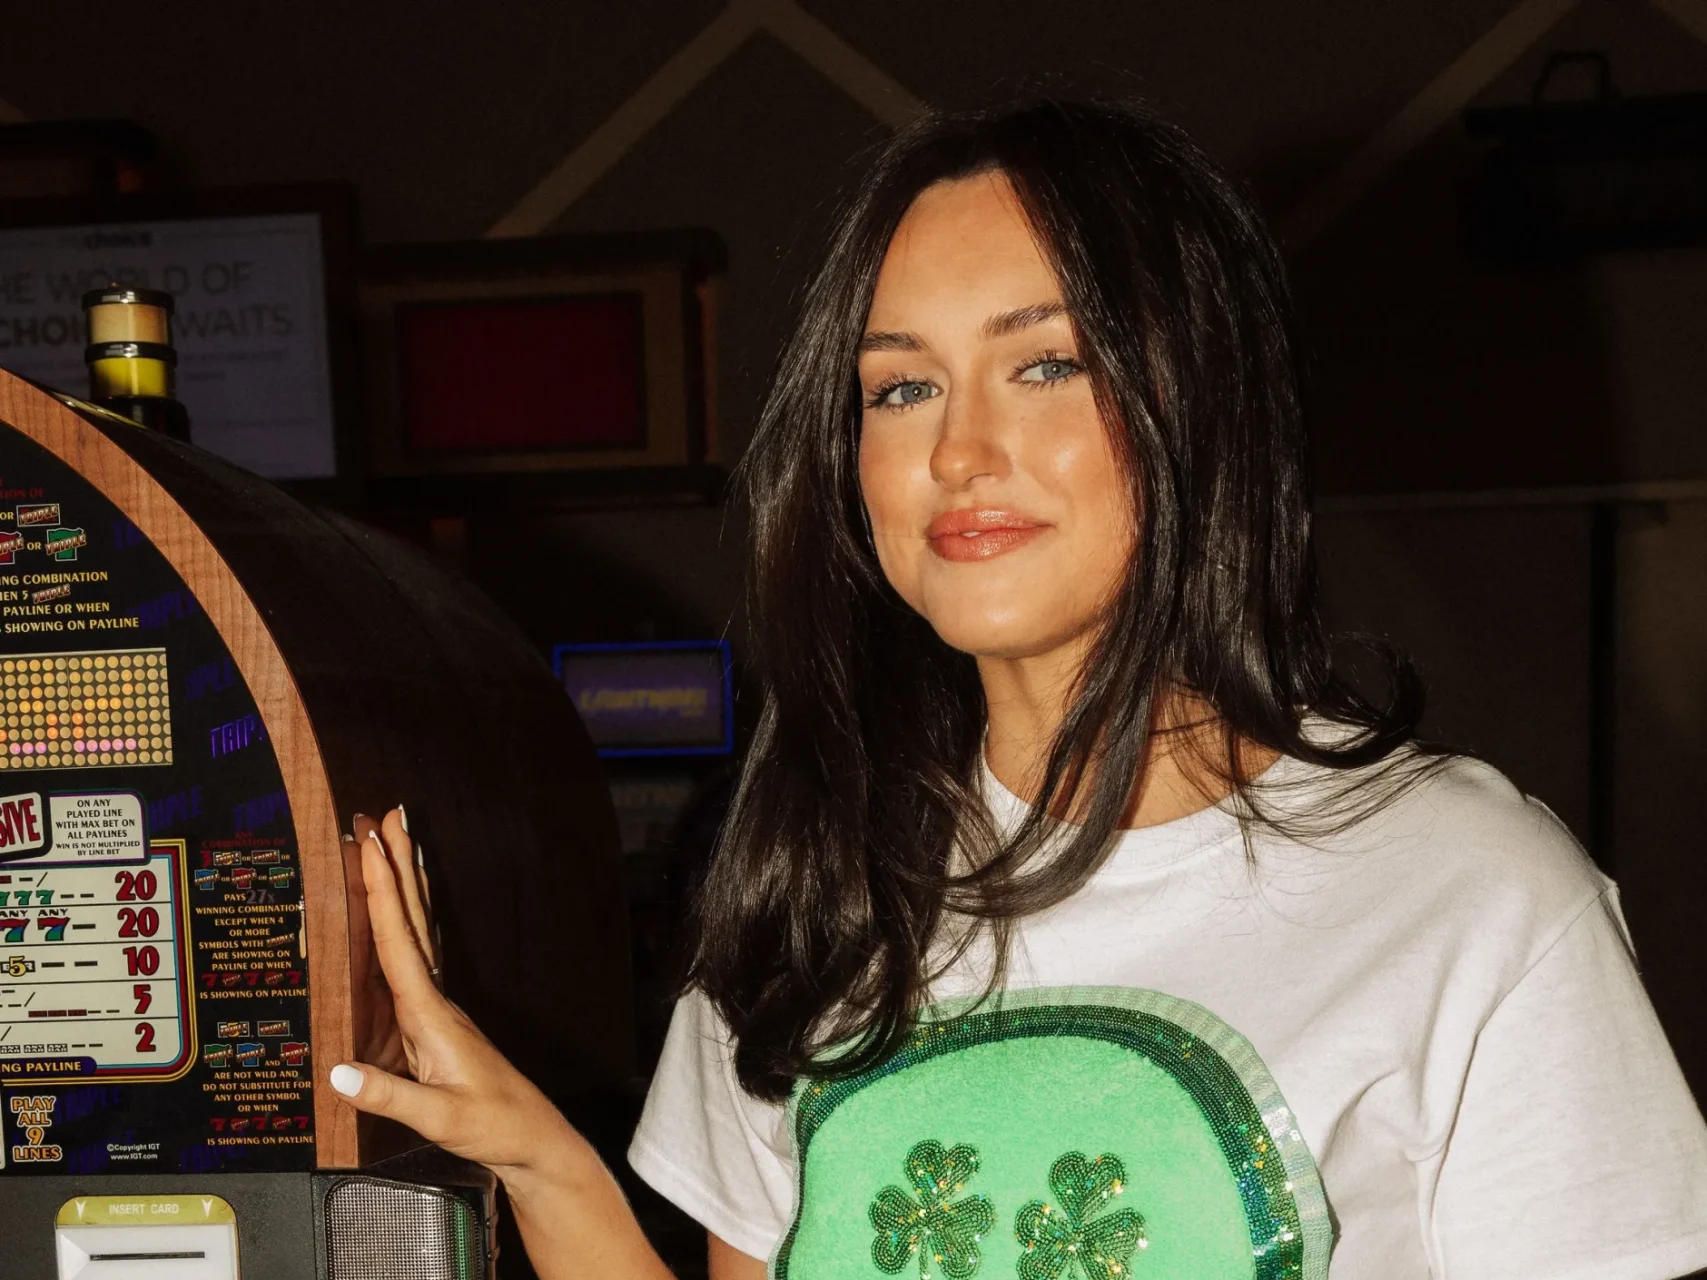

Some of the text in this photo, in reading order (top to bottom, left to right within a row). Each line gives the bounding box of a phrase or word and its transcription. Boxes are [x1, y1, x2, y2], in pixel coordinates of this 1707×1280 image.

[0, 272, 35, 304] HE
[202, 261, 253, 296] OF
[173, 303, 293, 338] WAITS
[0, 504, 58, 525] OR TRIPLE
[27, 541, 42, 551] OR
[45, 533, 87, 556] TRIPLE
[22, 571, 108, 585] COMBINATION
[22, 590, 29, 600] 5
[32, 583, 71, 604] TRIPLE
[3, 602, 110, 616] PAYLINE OR WHEN
[4, 617, 140, 633] SHOWING ON PAYLINE
[77, 799, 111, 808] ON ANY
[67, 809, 122, 819] PLAYED LINE
[56, 819, 135, 829] WITH MAX BET ON
[68, 830, 127, 839] ALL PAYLINES
[115, 870, 157, 901] 20
[224, 893, 246, 902] PAYS
[0, 908, 68, 918] ANY ANY
[195, 904, 301, 915] WINNING COMBINATION
[37, 917, 71, 941] 7
[117, 907, 159, 937] 20
[214, 916, 284, 926] EXCEPT WHEN 4
[229, 928, 270, 937] OR MORE
[199, 941, 238, 949] SYMBOLS
[241, 940, 263, 948] WITH
[122, 945, 160, 976] 10
[212, 952, 229, 960] ARE
[232, 951, 274, 959] SHOWING
[212, 962, 247, 971] PAYLINE
[133, 984, 152, 1014] 5
[200, 991, 208, 999] IS
[210, 990, 252, 999] SHOWING
[271, 988, 307, 997] PAYLINE
[135, 1022, 156, 1052] 2
[26, 1062, 81, 1072] PAYLINE
[234, 1071, 251, 1079] NOT
[254, 1070, 277, 1078] WILD
[279, 1070, 299, 1078] AND
[203, 1083, 216, 1091] DO
[240, 1081, 290, 1089] SUBSTITUTE
[234, 1093, 264, 1101] OTHER
[266, 1092, 301, 1100] SYMBOL
[12, 1097, 55, 1112] PLAY
[237, 1104, 250, 1112] OR
[19, 1113, 50, 1125] ALL
[27, 1128, 43, 1145] 9
[218, 1137, 260, 1145] SHOWING
[262, 1136, 276, 1144] ON
[278, 1135, 314, 1143] PAYLINE
[14, 1147, 61, 1161] LINES
[110, 1152, 158, 1160] www.IGT.com
[109, 1203, 179, 1215] INSERT CARD
